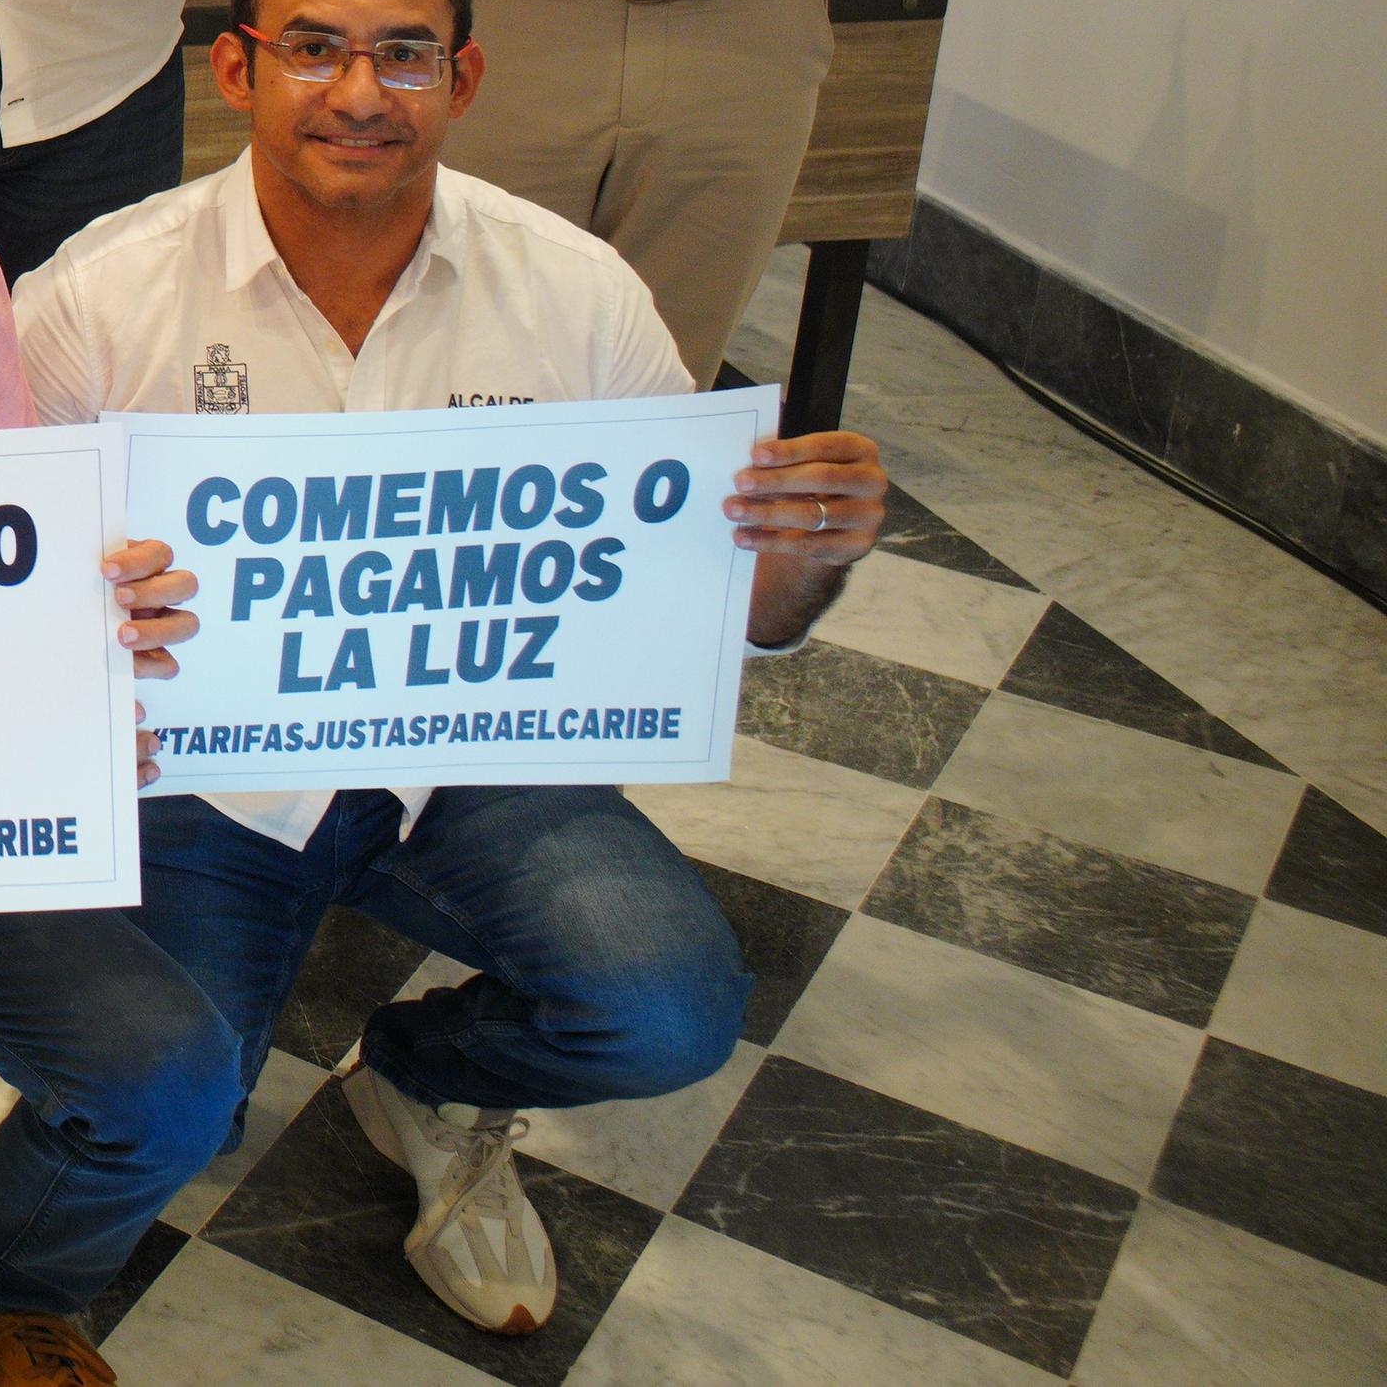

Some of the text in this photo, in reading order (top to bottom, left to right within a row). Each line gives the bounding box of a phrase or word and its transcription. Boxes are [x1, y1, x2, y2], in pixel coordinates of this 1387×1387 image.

[187, 459, 690, 546] COMEMOS O
[231, 537, 625, 621] PAGAMOS
[278, 616, 559, 693] LA LUZ
